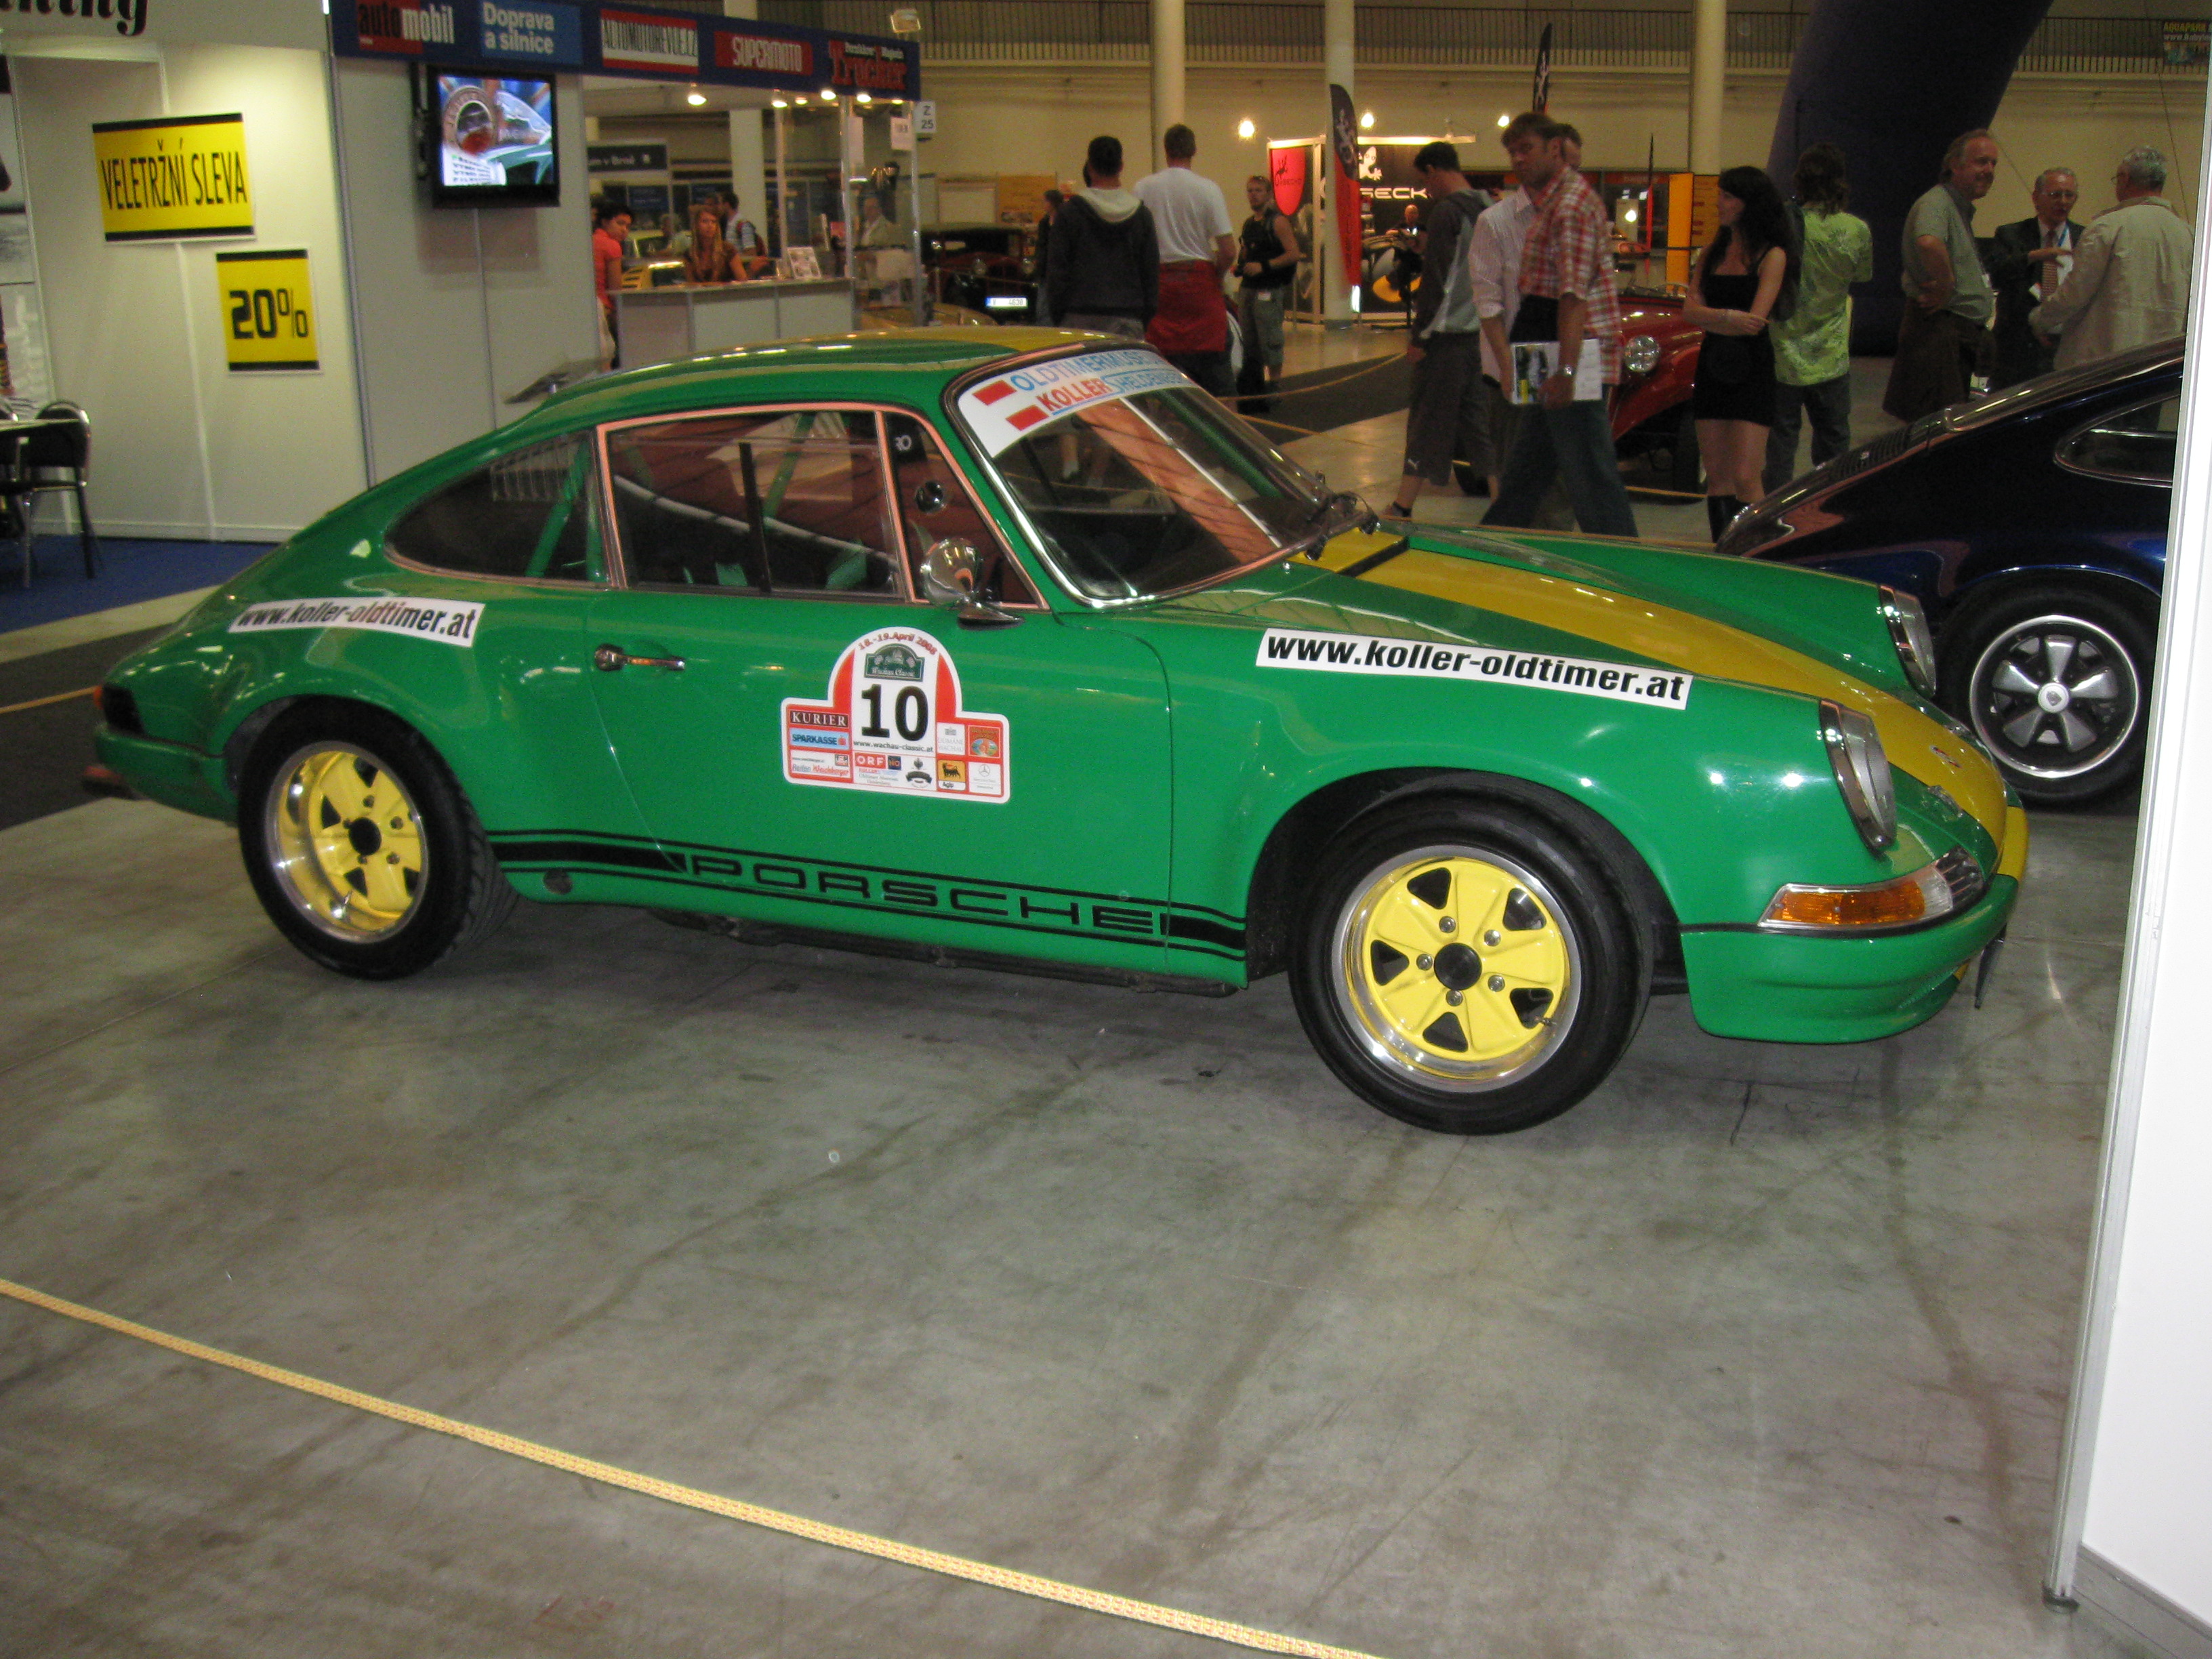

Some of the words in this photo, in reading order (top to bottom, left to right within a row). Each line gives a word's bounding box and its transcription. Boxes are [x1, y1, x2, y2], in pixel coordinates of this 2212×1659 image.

[483, 1, 554, 33] Doprava
[485, 31, 497, 49] a
[499, 29, 554, 54] silnice
[732, 35, 803, 73] SUPERMOTO
[921, 119, 934, 129] 25
[923, 105, 931, 116] Z
[100, 138, 187, 210] VELETRŽNÍ
[194, 152, 247, 208] SLEVA
[228, 288, 308, 340] 20%
[1036, 377, 1114, 412] KOLLER
[238, 601, 477, 639] www.koller-oldtimer.at
[1268, 635, 1685, 701] www.koller-oldtimer.at
[792, 712, 846, 726] KURIER
[861, 683, 928, 741] 10
[792, 733, 838, 745] SPARKASSE
[853, 741, 934, 752] www.wachau-classic.at
[857, 755, 884, 766] ORF
[693, 854, 1154, 934] PORSCHE
